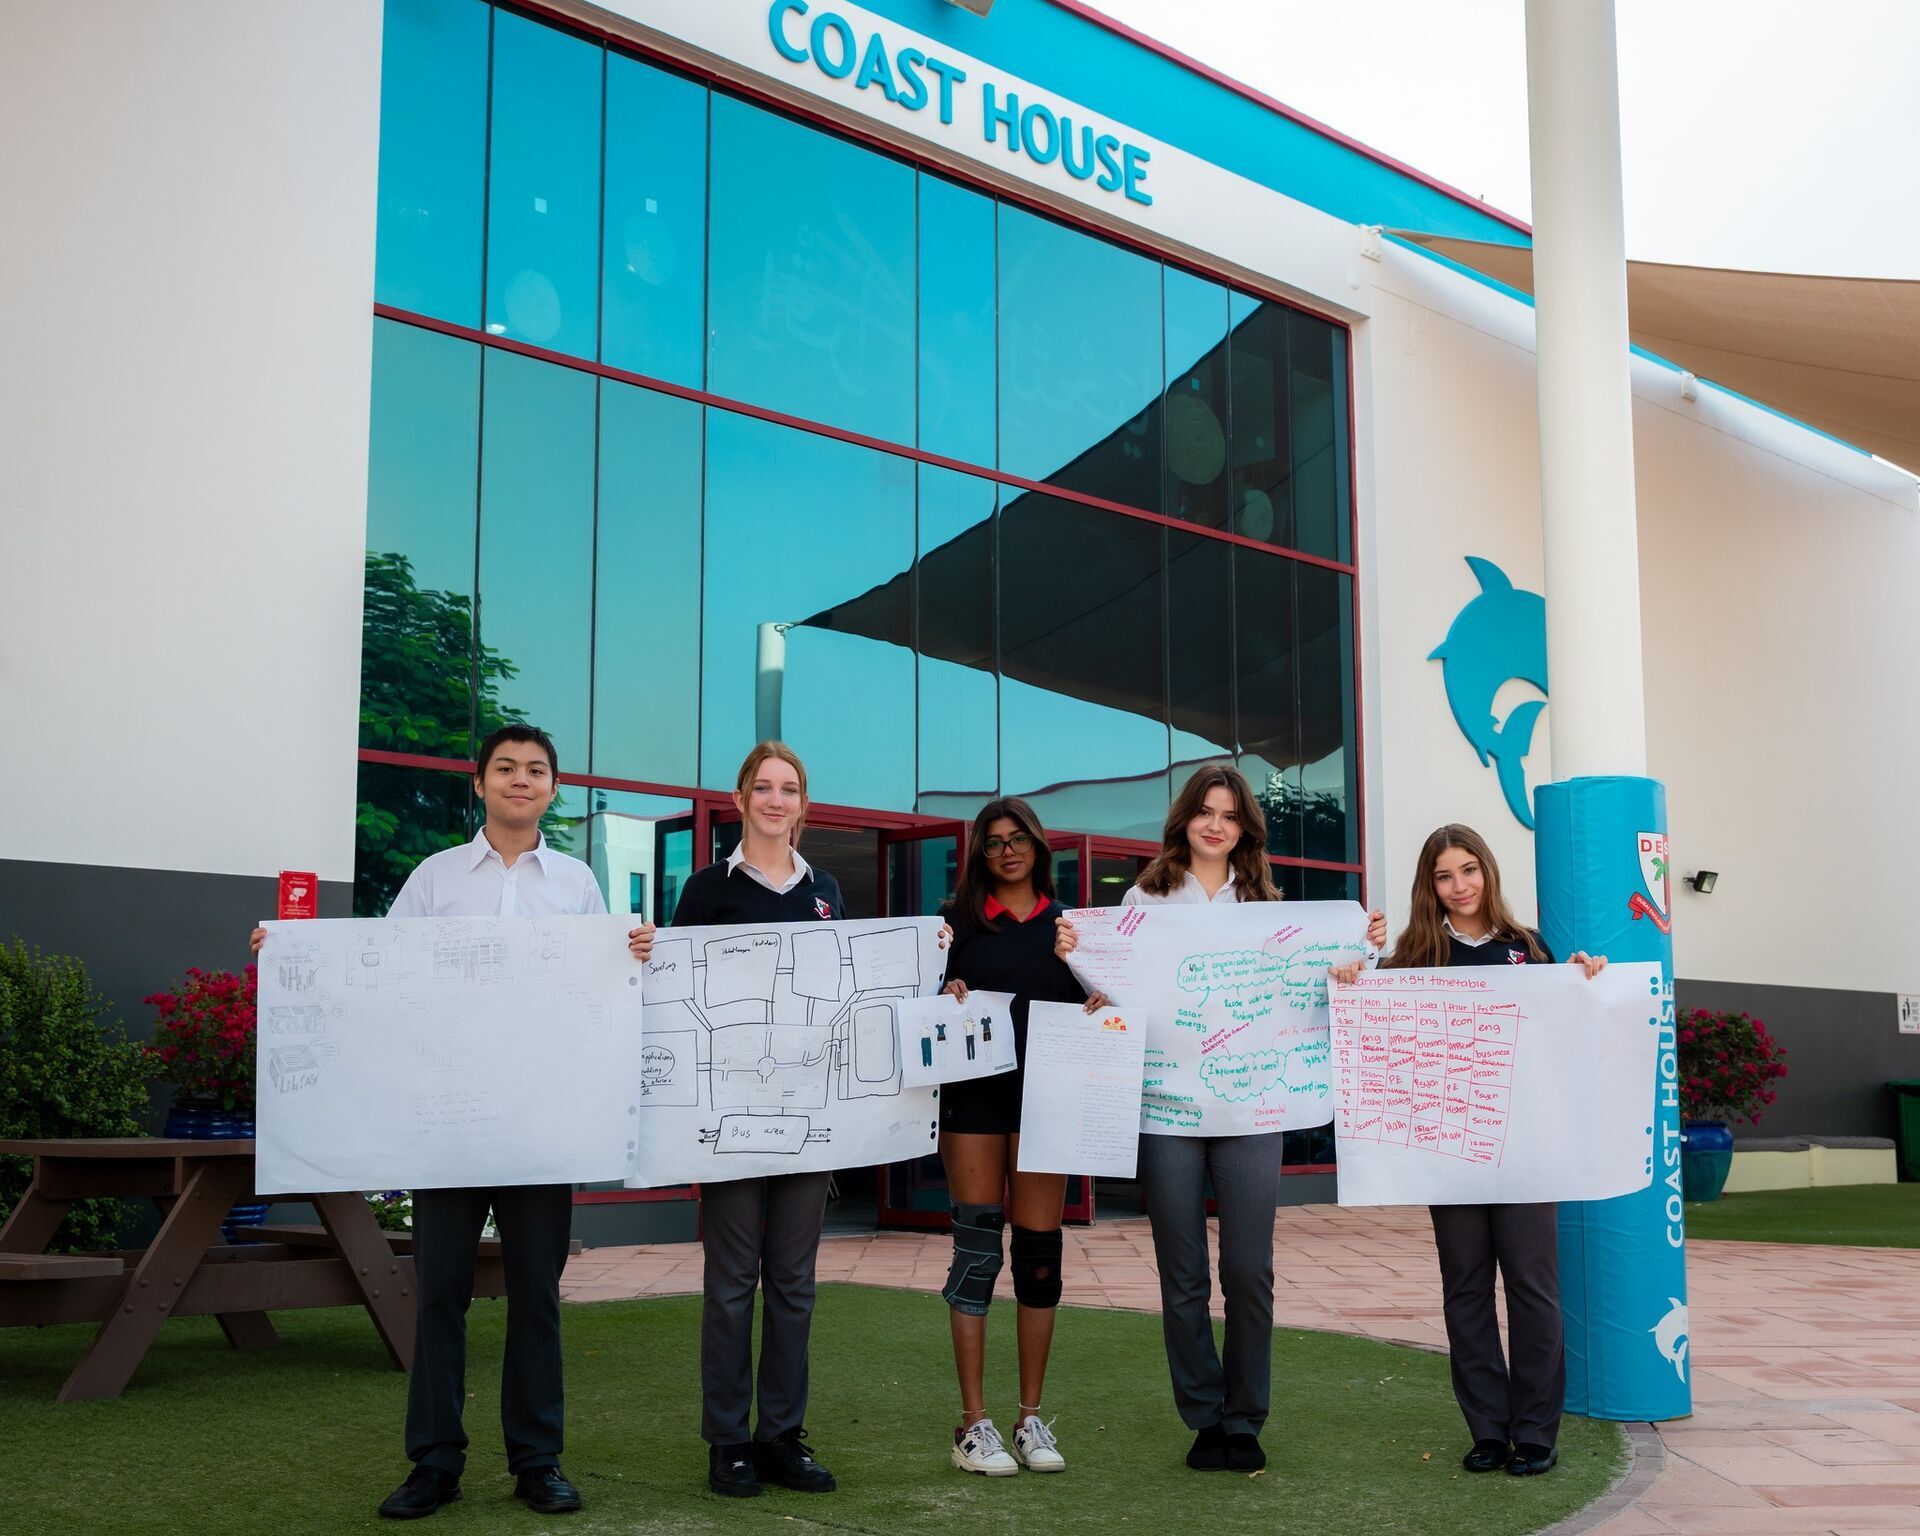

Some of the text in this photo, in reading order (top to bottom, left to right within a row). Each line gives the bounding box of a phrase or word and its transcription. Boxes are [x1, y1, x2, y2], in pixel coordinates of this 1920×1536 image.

[768, 0, 1153, 206] COAST HOUSE
[1428, 975, 1488, 989] timetable
[1174, 1018, 1207, 1034] energy
[1390, 1014, 1414, 1022] econ
[1419, 1017, 1439, 1028] eng
[1450, 1017, 1473, 1027] econ
[1478, 1024, 1501, 1035] eng
[1361, 1034, 1382, 1044] eng
[1475, 1049, 1510, 1059] business
[1388, 1074, 1403, 1086] PE
[1473, 1070, 1500, 1080] Arabic
[1159, 1092, 1194, 1103] lessons
[1660, 980, 1684, 1249] COAST HOUSE
[731, 1125, 751, 1139] Bus
[763, 1127, 786, 1136] area
